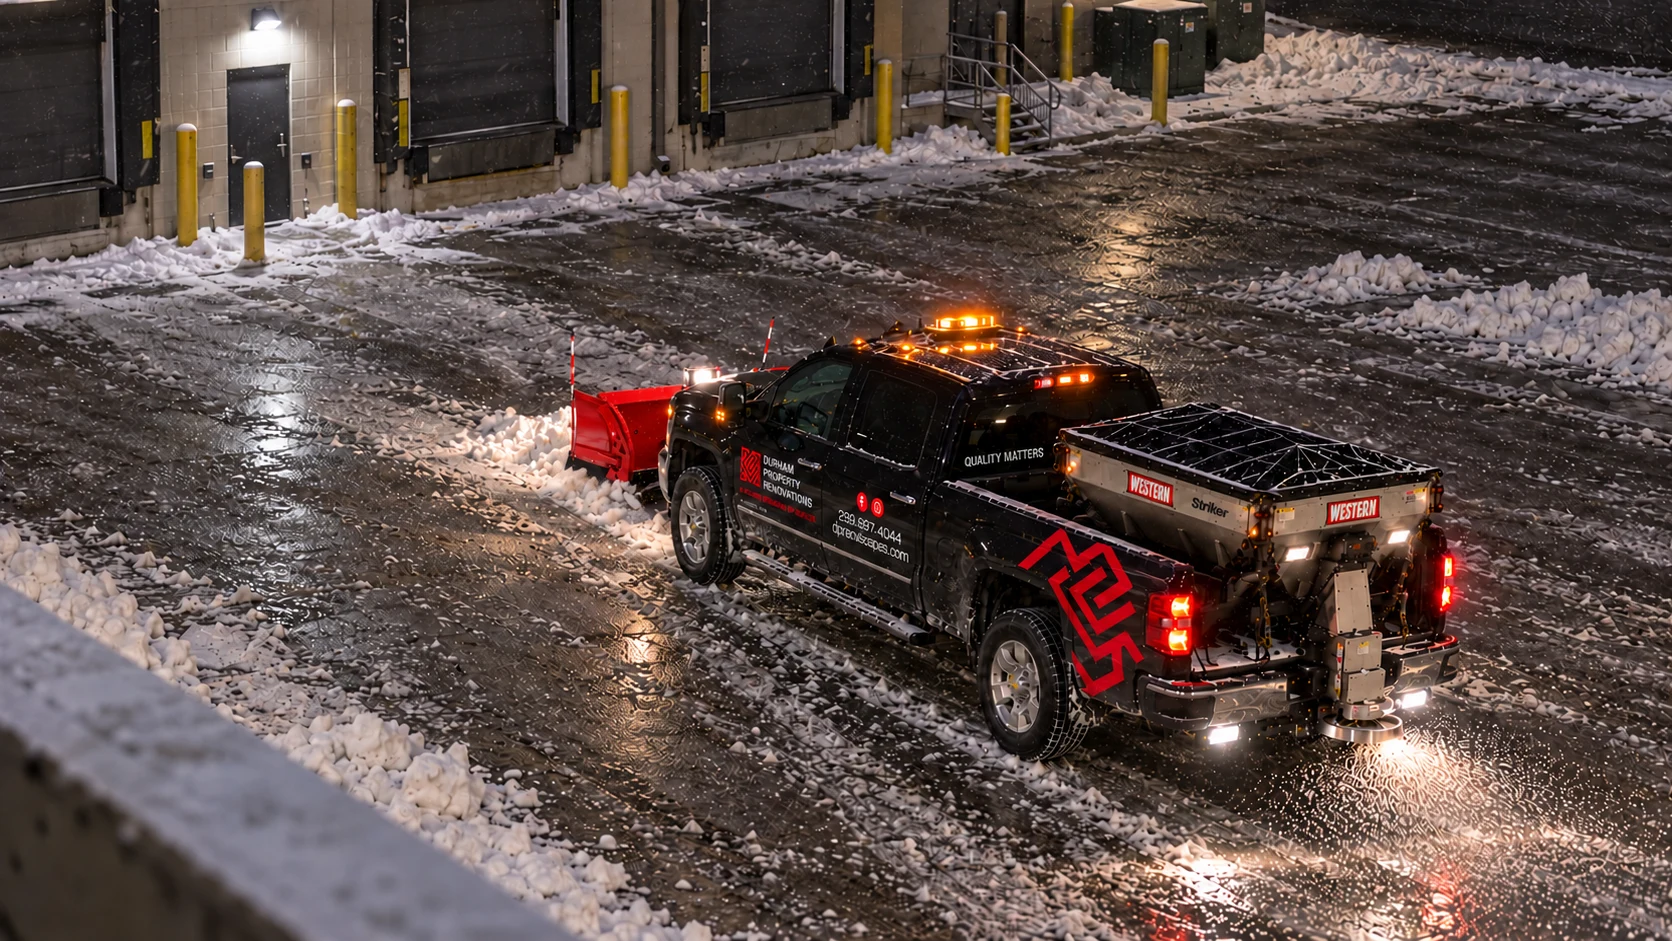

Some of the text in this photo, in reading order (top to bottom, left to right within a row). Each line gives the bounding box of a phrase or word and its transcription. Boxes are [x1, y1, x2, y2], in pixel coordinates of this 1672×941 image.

[763, 455, 795, 475] DURHAM
[964, 447, 1044, 467] QUALITY MATTERS
[763, 468, 801, 490] PROPERTY
[1131, 474, 1171, 504] WESTERN
[763, 480, 813, 508] RENOVATIONS
[1191, 497, 1229, 518] Striker
[1330, 499, 1378, 522] WESTERN
